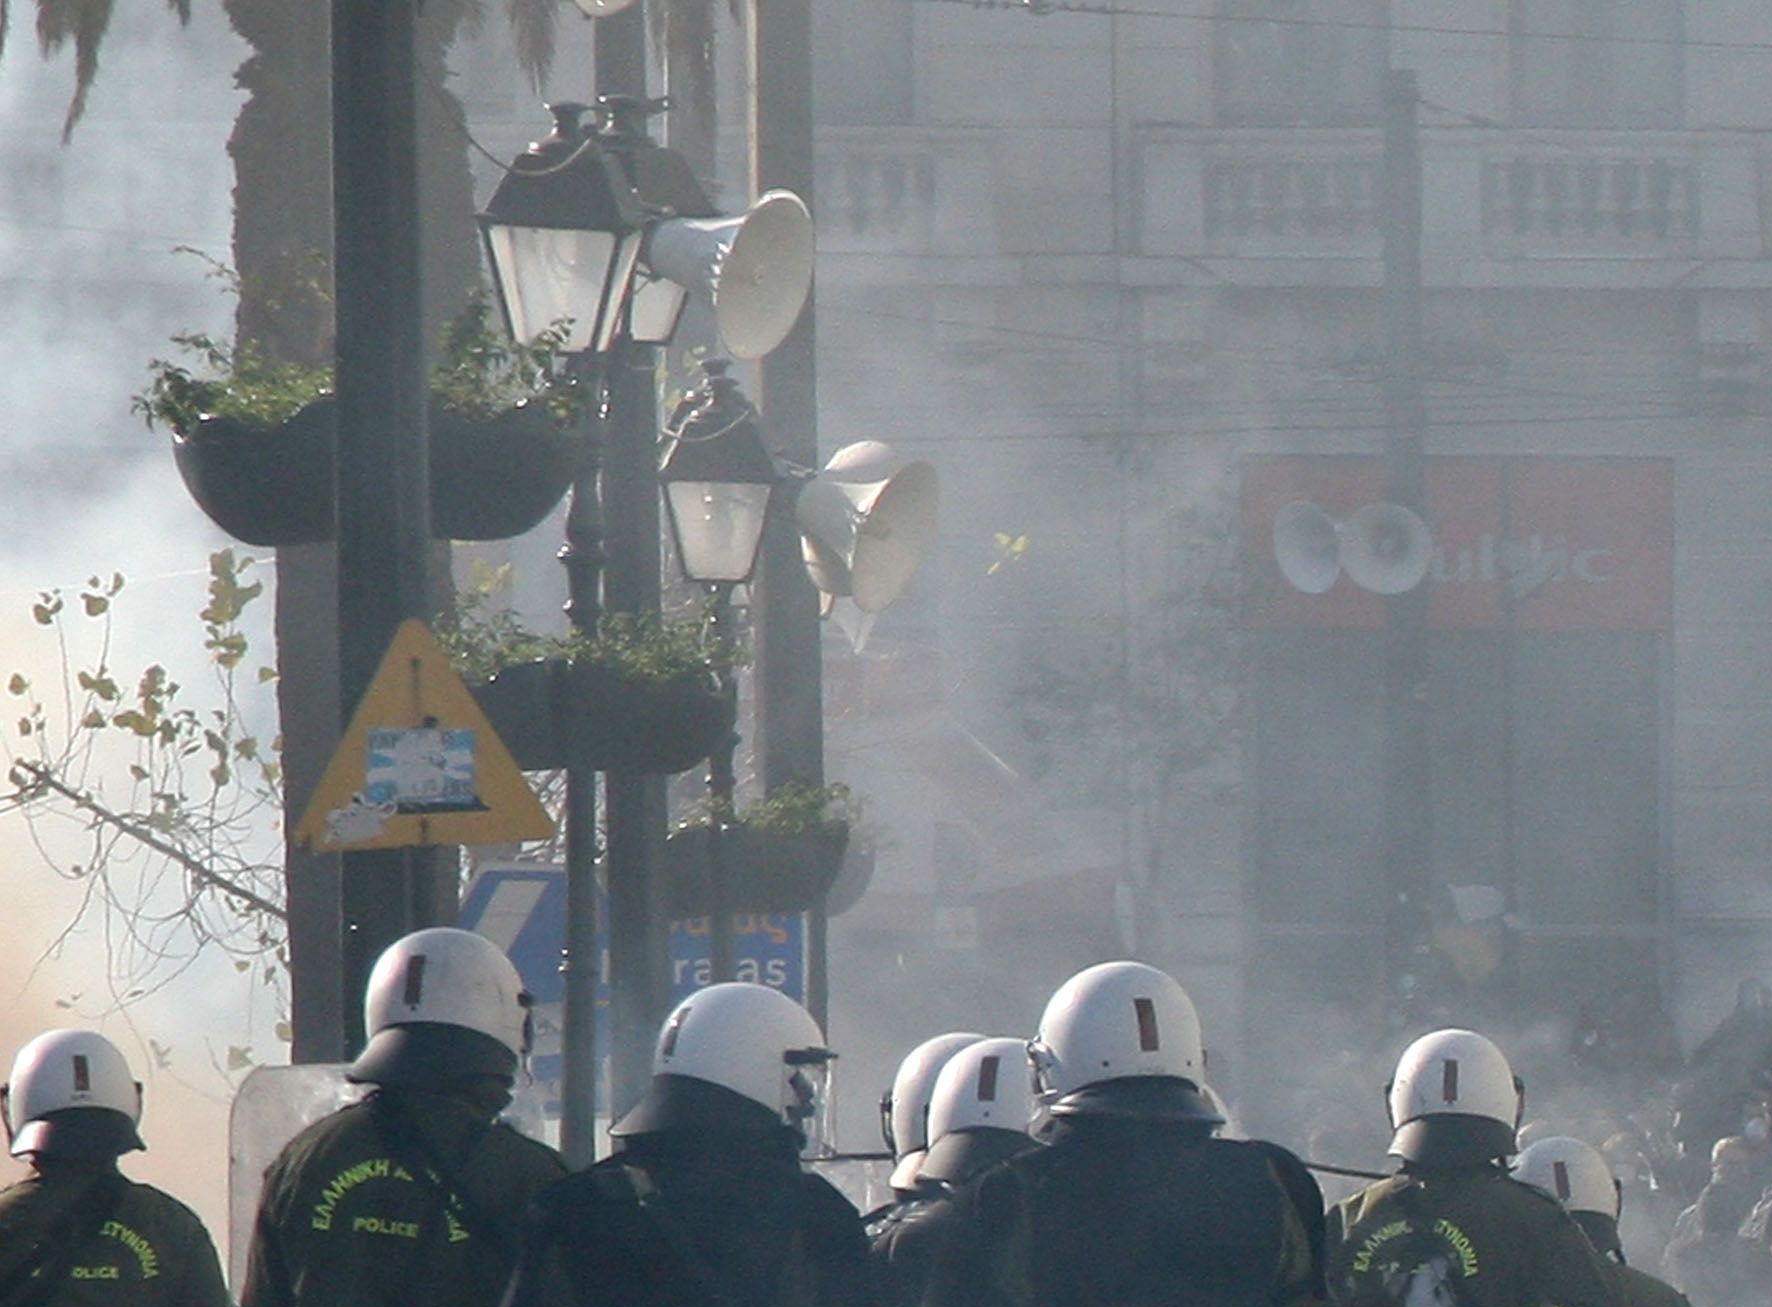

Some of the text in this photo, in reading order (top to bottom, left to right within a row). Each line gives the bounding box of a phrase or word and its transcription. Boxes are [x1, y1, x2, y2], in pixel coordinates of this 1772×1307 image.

[353, 1216, 419, 1238] POLICE
[102, 1220, 159, 1279] ΣΤΥΝΟΜΙΑ
[1353, 1218, 1480, 1278] ΕΛΛΗΝΙΚ ΣΤΥΝΟΜΙΑ
[71, 1266, 120, 1279] OLICE
